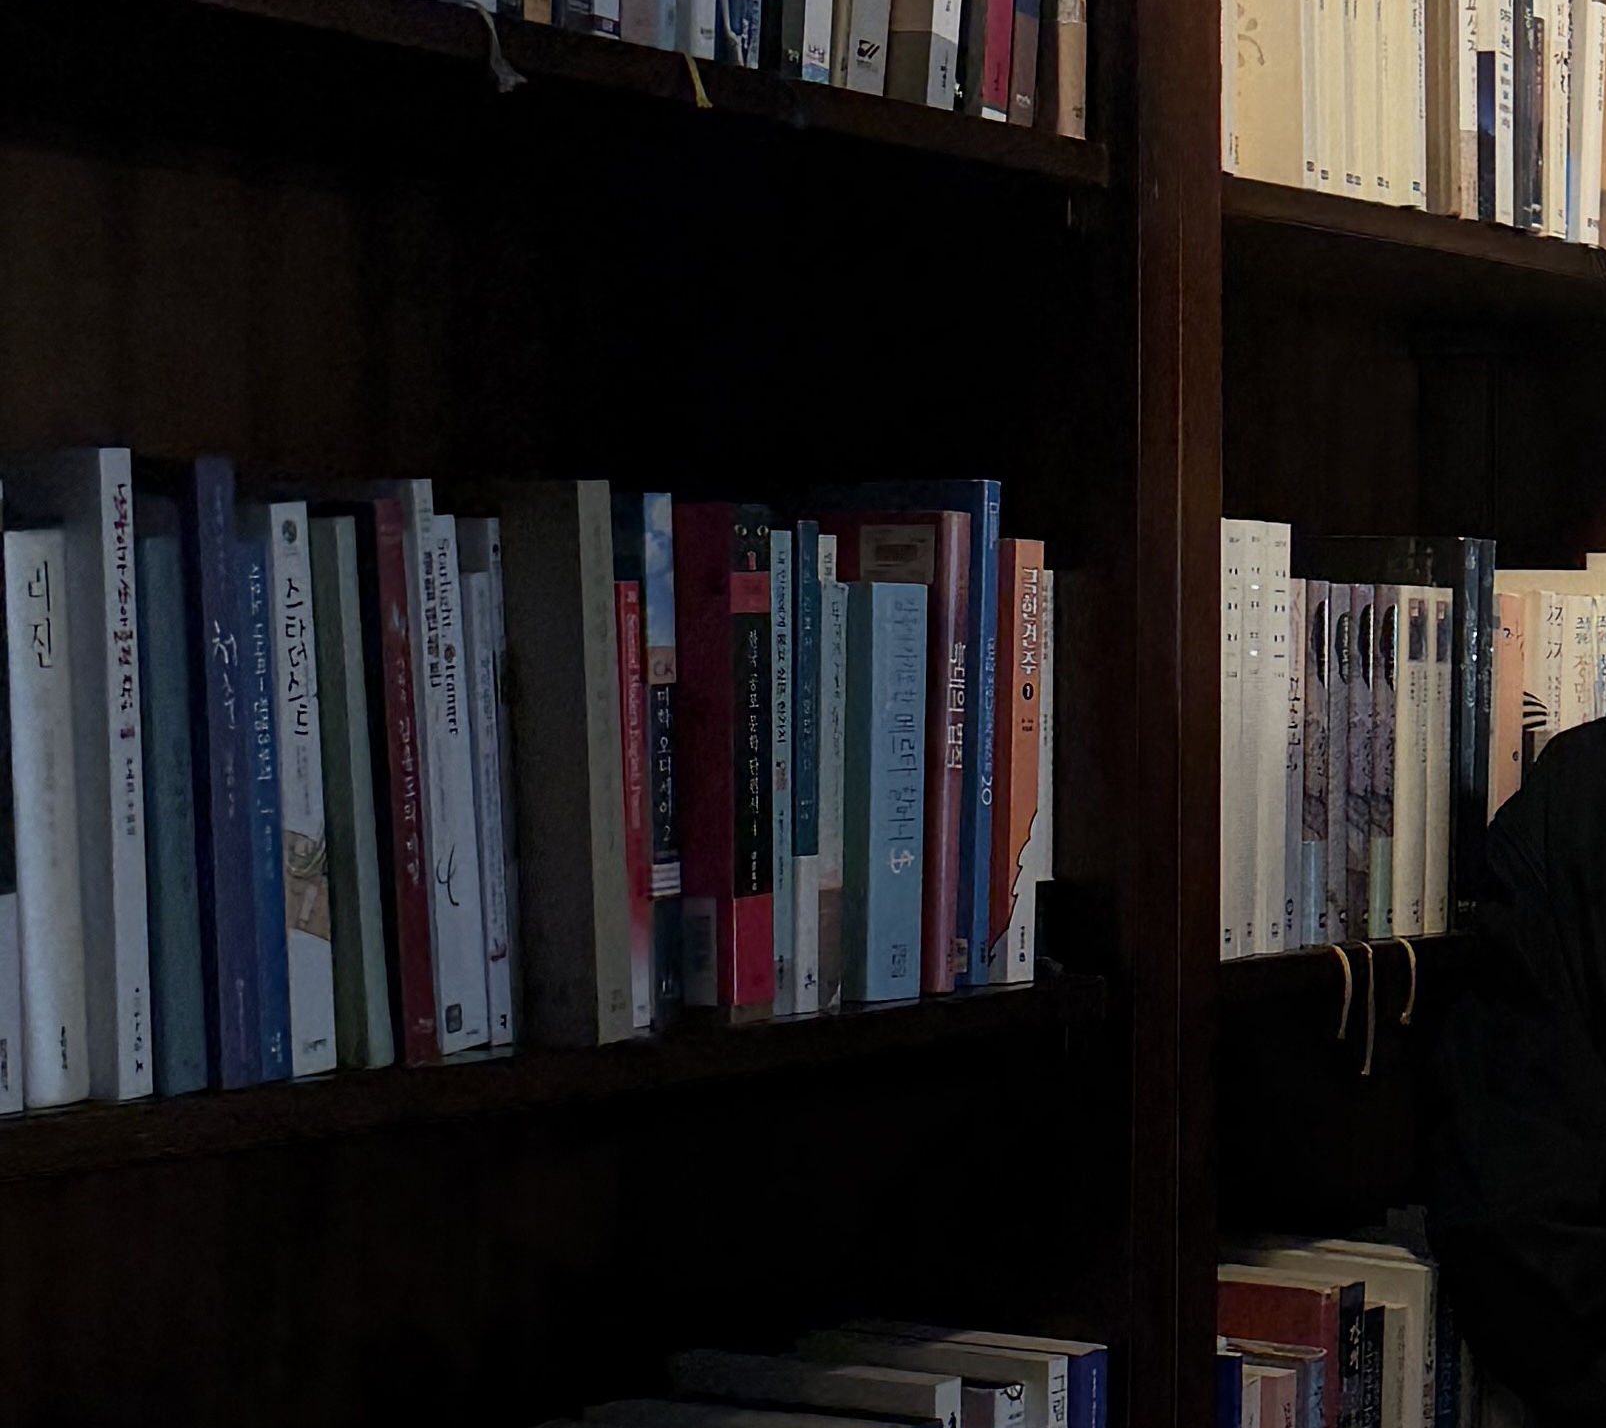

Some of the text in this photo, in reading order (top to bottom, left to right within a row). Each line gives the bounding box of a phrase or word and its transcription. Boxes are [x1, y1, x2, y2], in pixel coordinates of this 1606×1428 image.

[944, 640, 967, 770] 늑대의 법칙
[888, 711, 918, 773] 메르타
[888, 784, 916, 841] 할머니
[981, 774, 993, 806] 20
